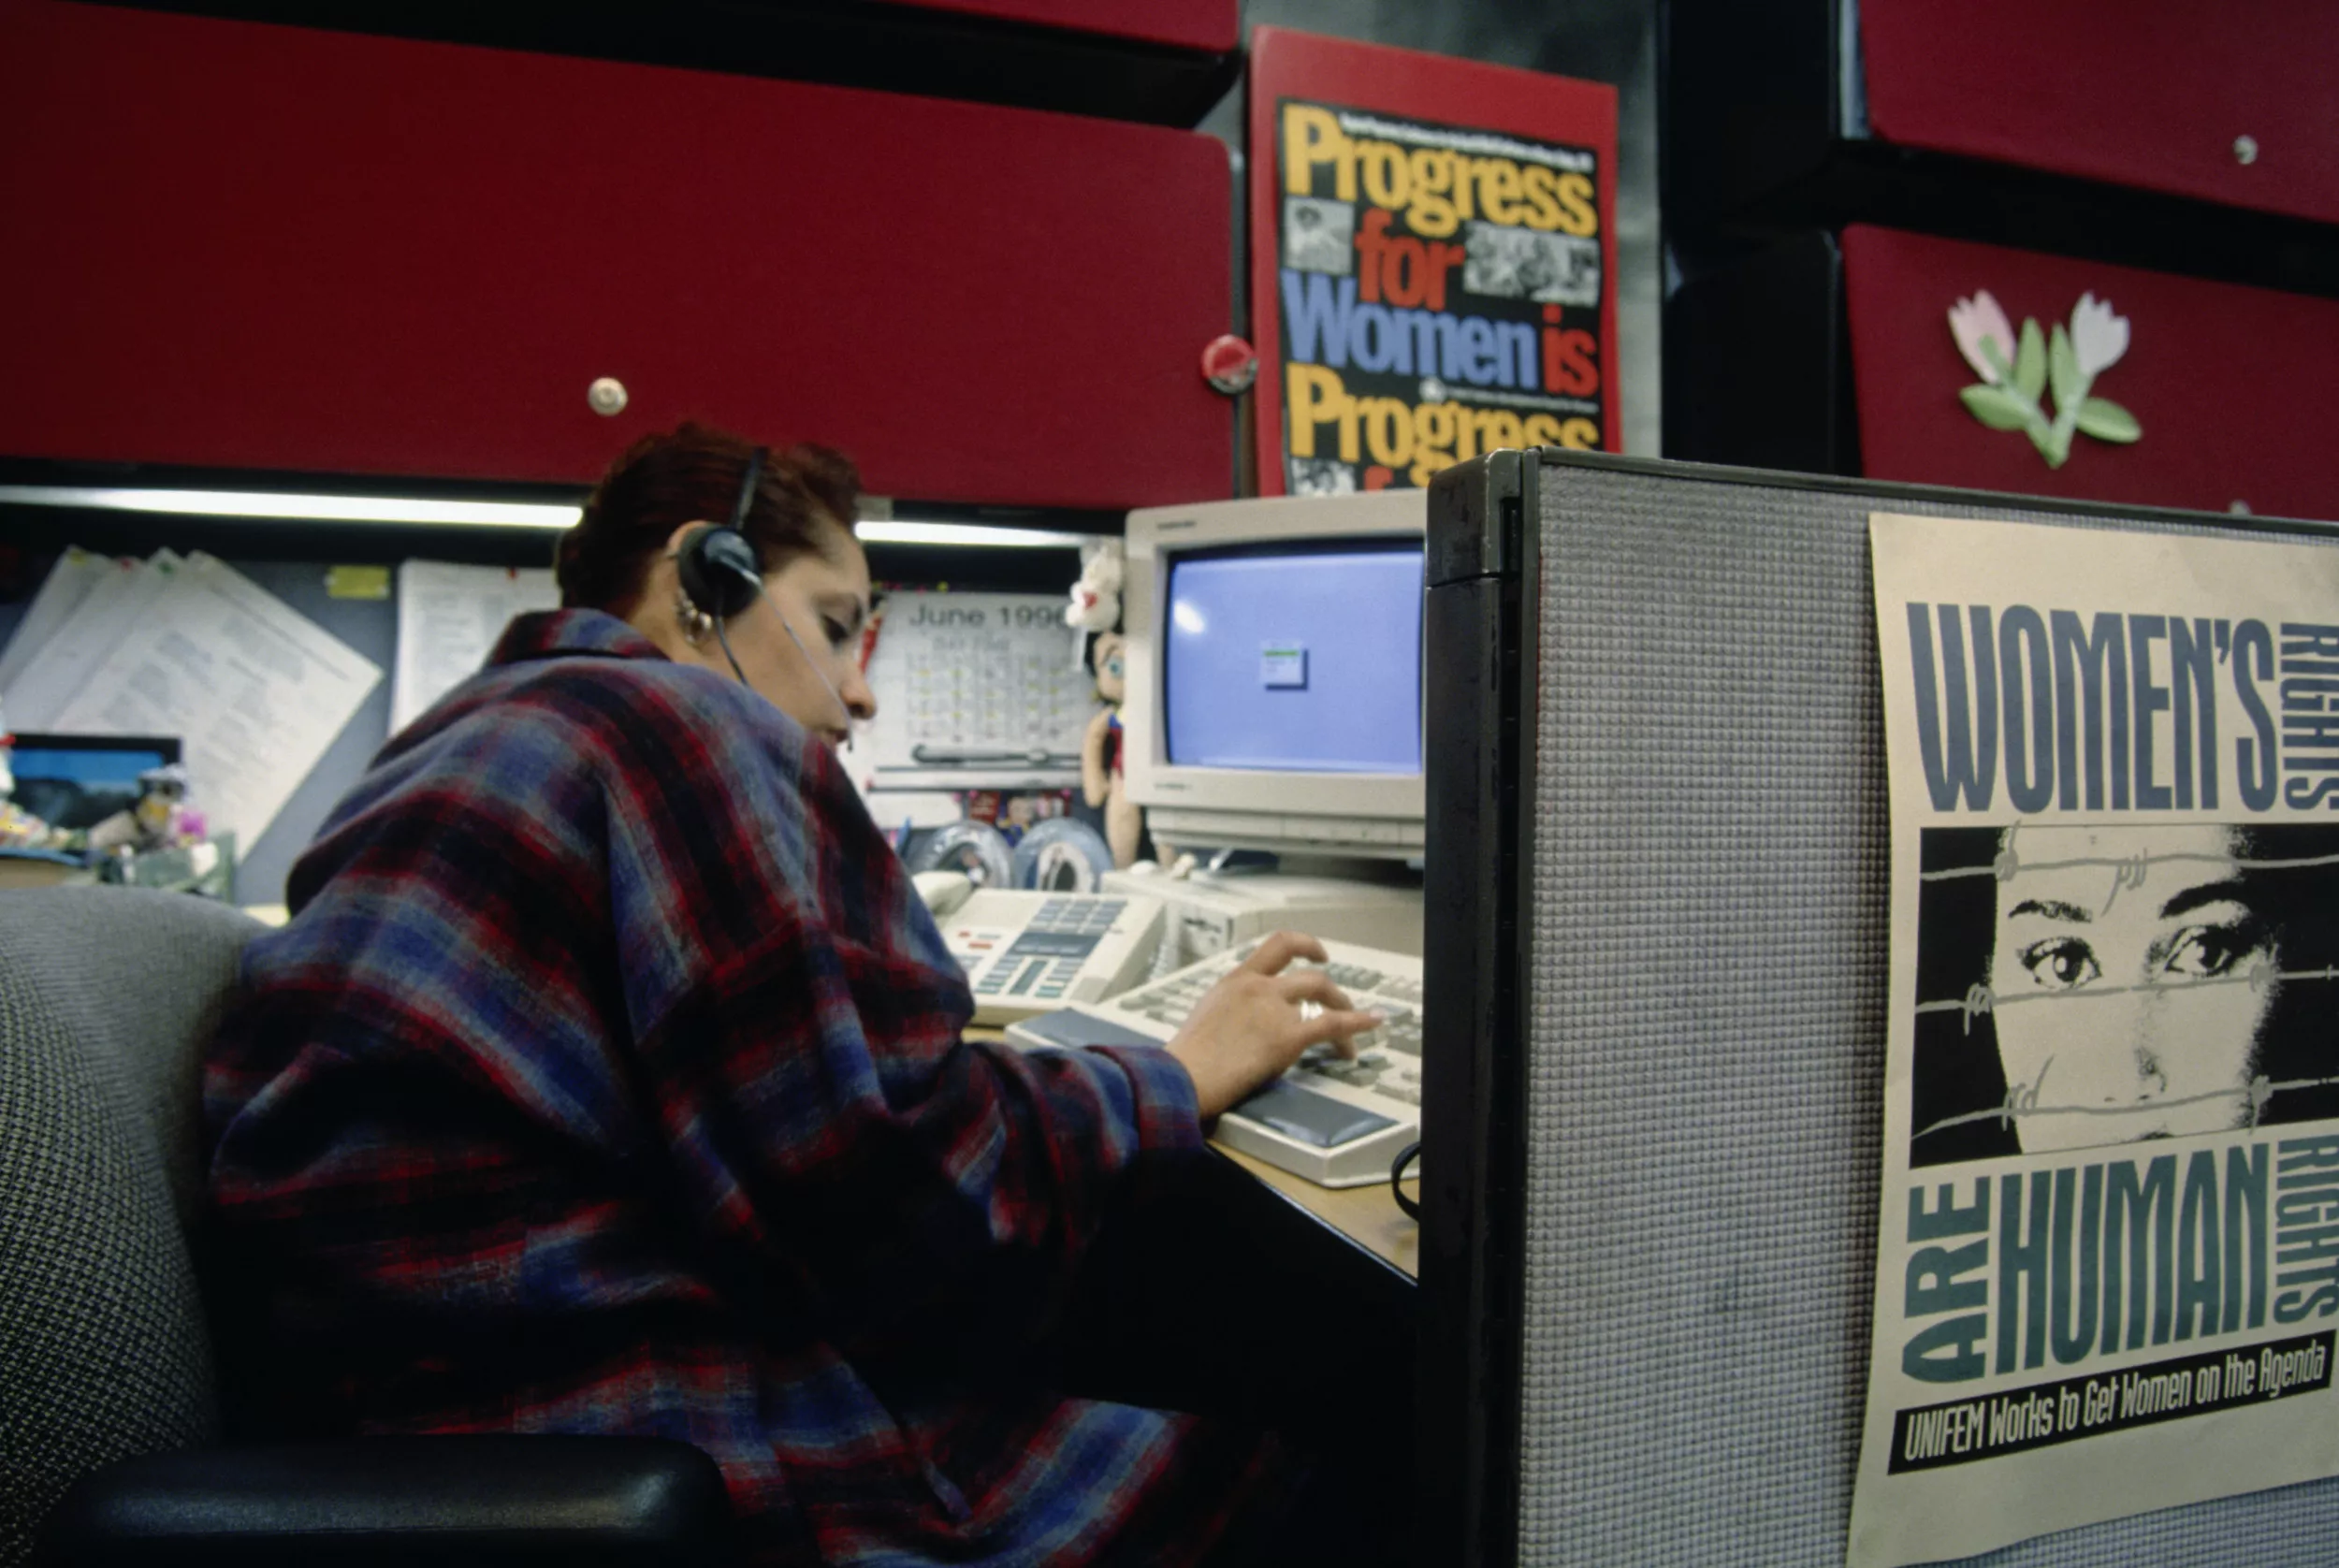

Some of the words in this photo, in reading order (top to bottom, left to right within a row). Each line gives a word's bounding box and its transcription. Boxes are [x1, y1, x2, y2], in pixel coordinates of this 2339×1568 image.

[1283, 103, 1599, 238] Progress
[1281, 269, 1539, 390] Women
[1542, 304, 1600, 397] is
[1355, 207, 1465, 311] for
[908, 604, 985, 628] June
[1906, 603, 2277, 814] WOMEN'S
[2280, 622, 2339, 810] RIGHTS
[1901, 1176, 1991, 1384] ARE
[1996, 1142, 2270, 1376] HUMAN
[2274, 1134, 2339, 1324] RIGHTS
[1904, 1401, 1985, 1461] UNIFEM
[1989, 1391, 2055, 1446] Works
[2058, 1386, 2080, 1432] to
[2084, 1375, 2119, 1427] Get
[2120, 1371, 2192, 1419] Women
[2196, 1365, 2221, 1404] on
[2224, 1353, 2256, 1399] the
[2259, 1339, 2326, 1399] Agenda
